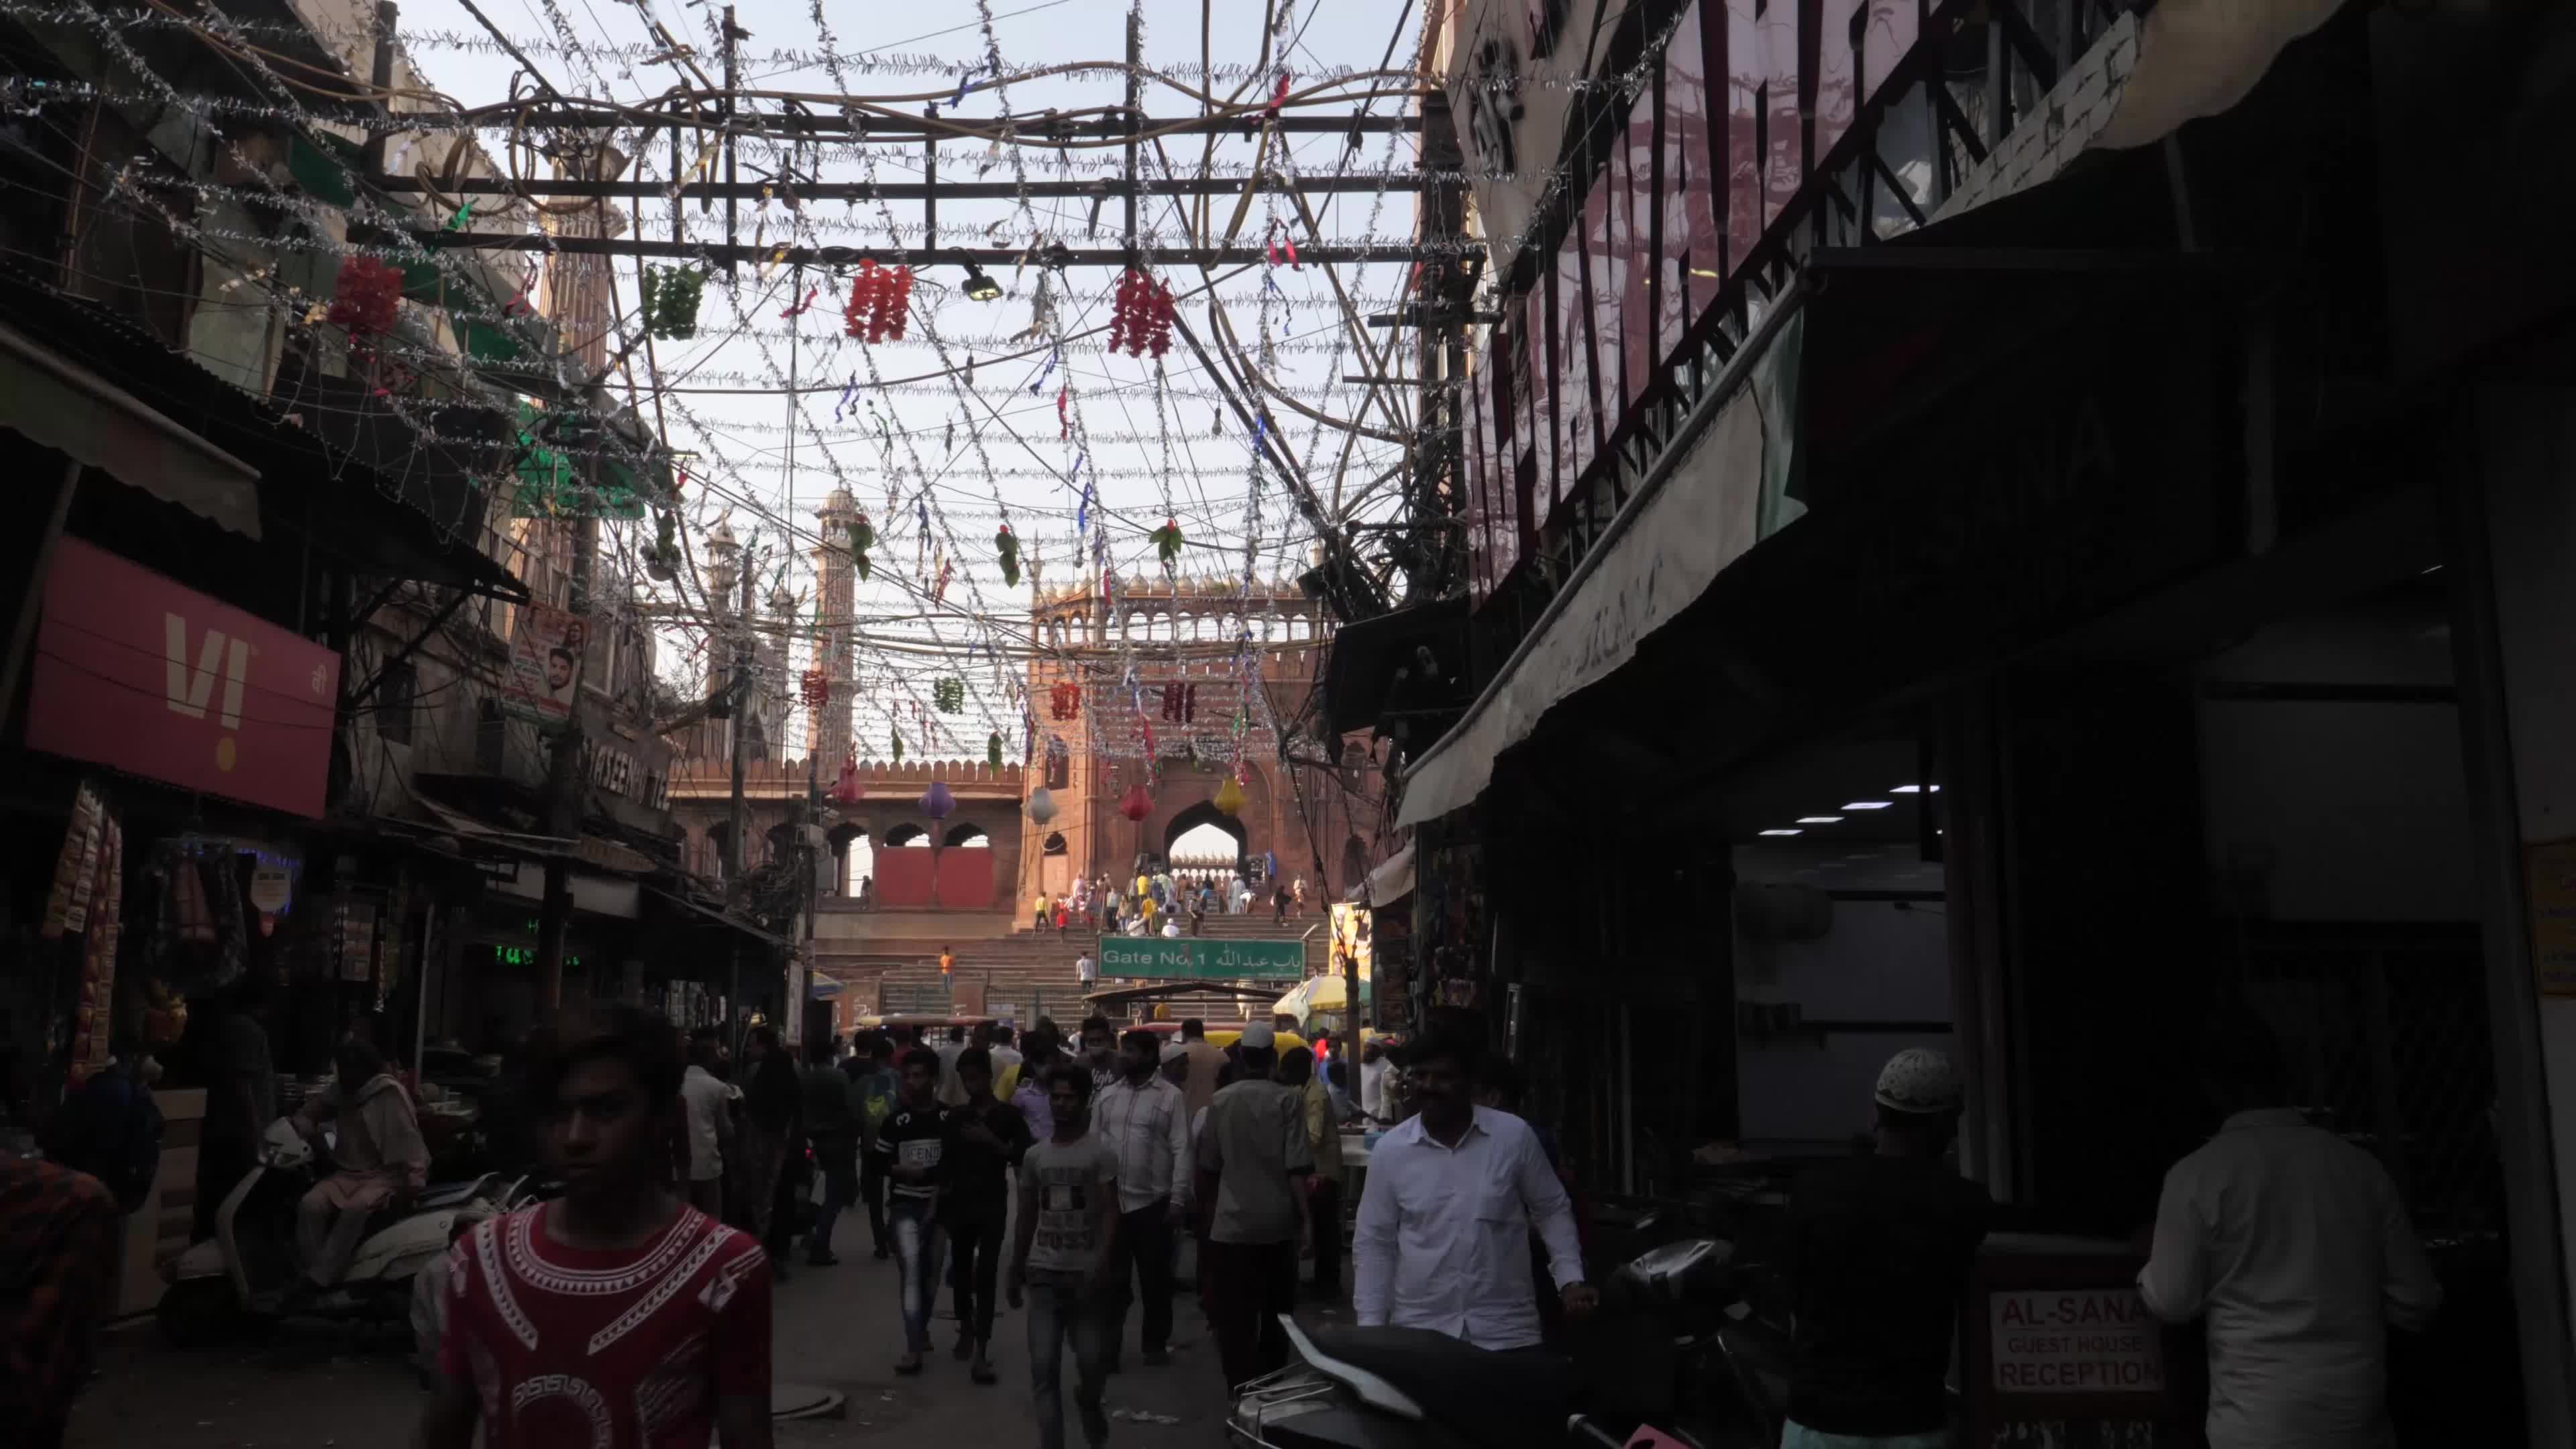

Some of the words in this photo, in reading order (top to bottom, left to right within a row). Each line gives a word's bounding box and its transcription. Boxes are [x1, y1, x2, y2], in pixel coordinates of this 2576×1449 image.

[1102, 949, 1153, 965] Gate
[1197, 953, 1206, 965] 1
[2001, 1295, 2149, 1325] AL-SANA
[2008, 1336, 2072, 1354] GUEST
[2078, 1336, 2142, 1354] HOUSE
